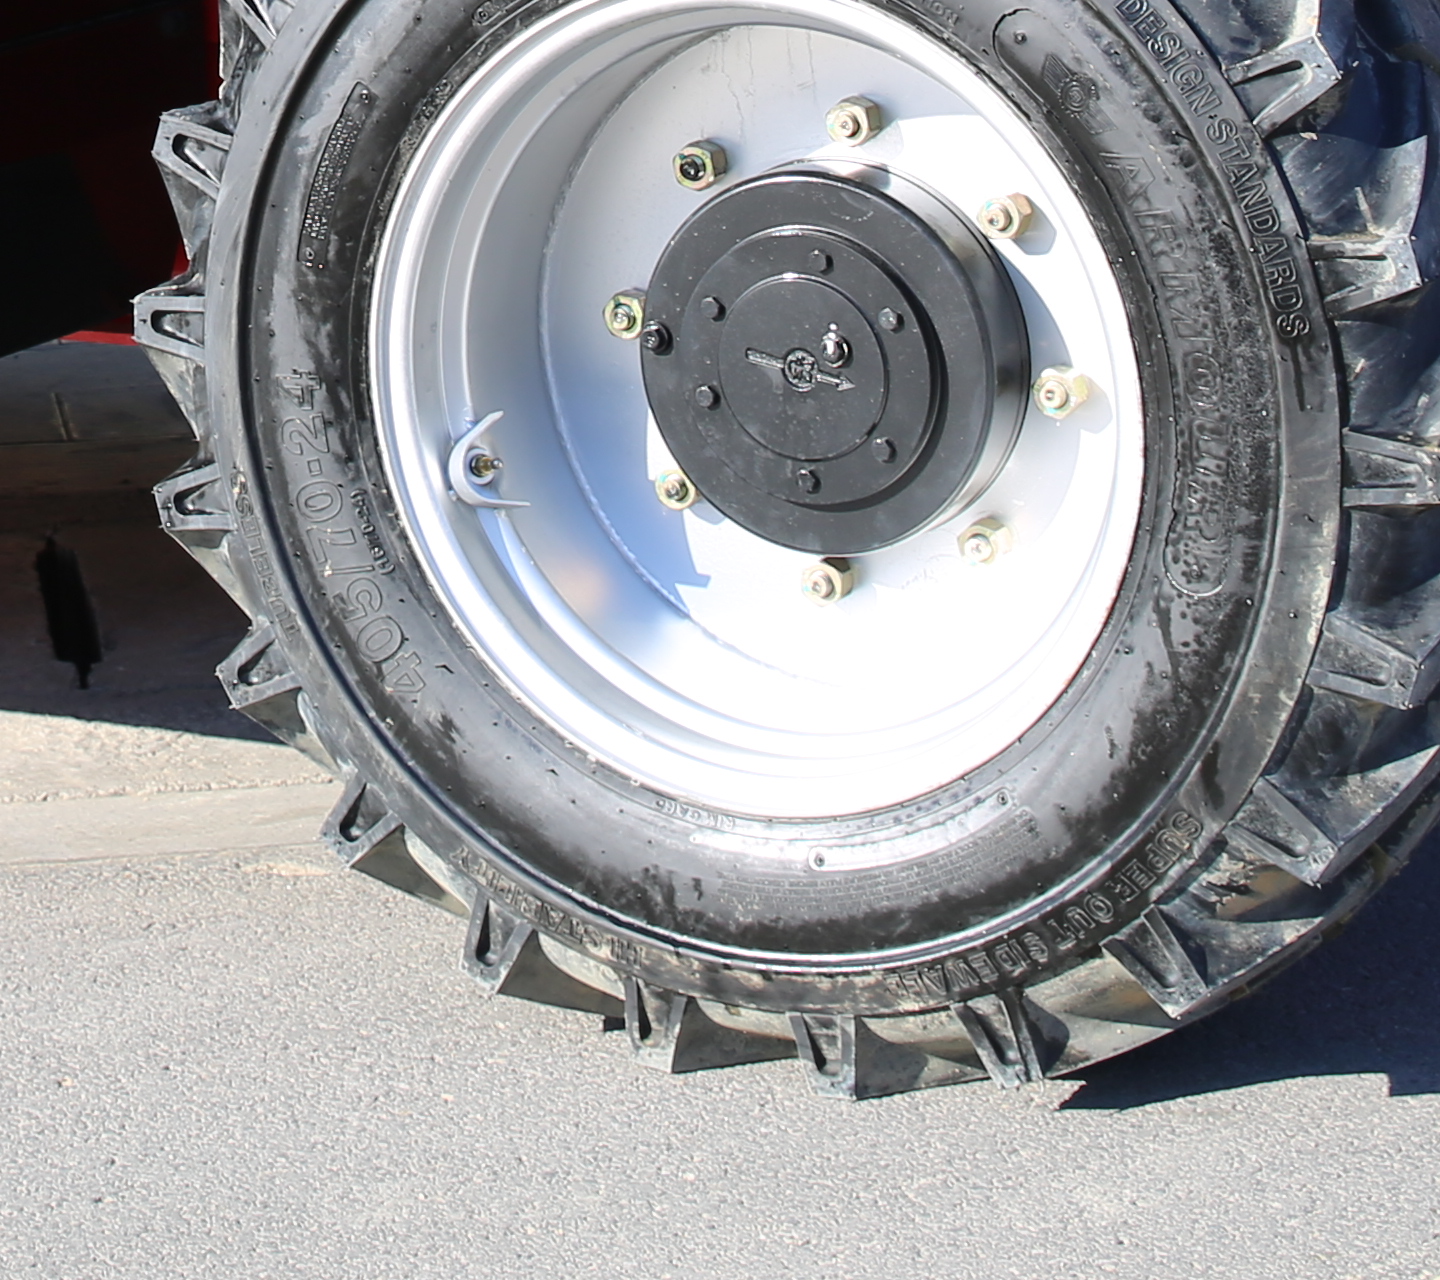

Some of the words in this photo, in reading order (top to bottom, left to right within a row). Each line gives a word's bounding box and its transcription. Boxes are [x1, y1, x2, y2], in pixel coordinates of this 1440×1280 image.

[1205, 117, 1310, 338] STANDARDS
[231, 469, 301, 641] TUBELESS
[277, 367, 426, 694] 405/70-24
